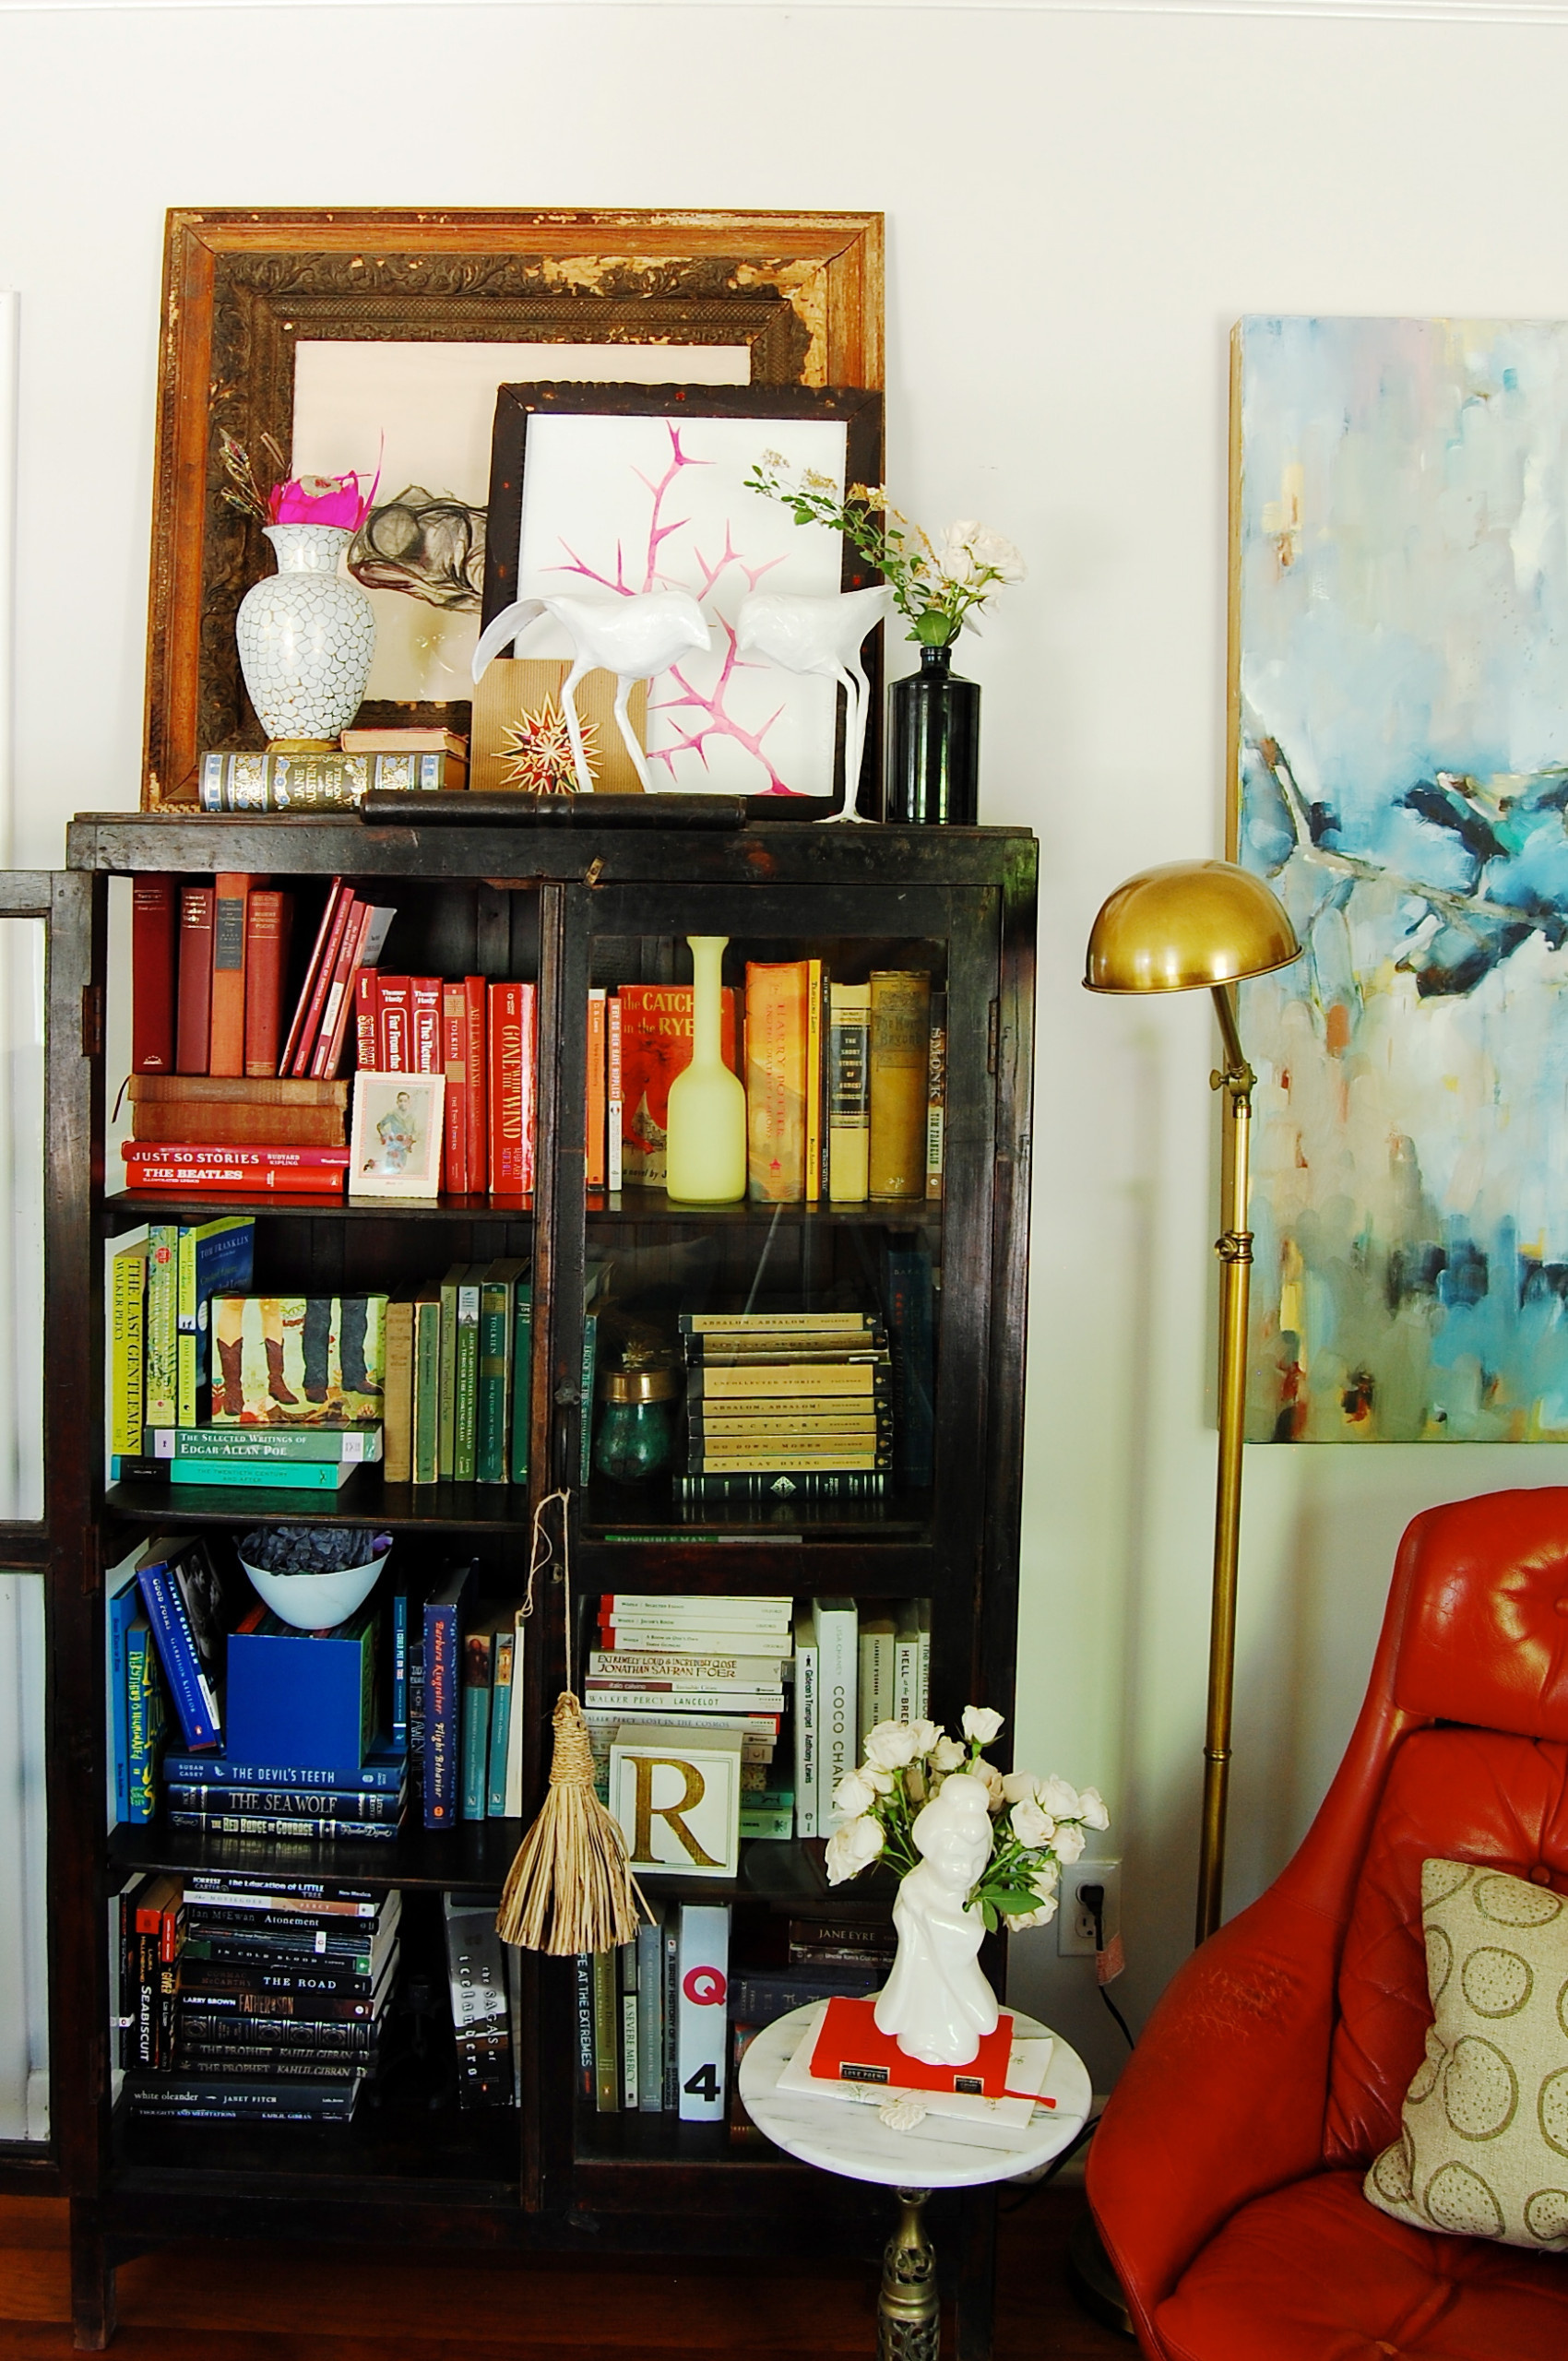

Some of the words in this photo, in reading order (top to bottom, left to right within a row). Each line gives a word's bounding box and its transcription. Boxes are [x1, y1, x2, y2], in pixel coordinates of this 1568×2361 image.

[305, 763, 316, 804] AUSTEN
[624, 993, 641, 1010] the
[388, 1015, 400, 1029] Far
[421, 1018, 433, 1039] The
[624, 1023, 634, 1033] in
[638, 1017, 655, 1034] the
[659, 1017, 694, 1037] RYE
[389, 1031, 401, 1053] From
[776, 1004, 786, 1067] HARRY
[502, 1025, 521, 1070] GONE
[390, 1054, 401, 1069] the
[503, 1096, 521, 1139] WIND
[132, 1153, 170, 1161] JUST
[173, 1153, 193, 1162] SO
[196, 1153, 259, 1164] STORIES
[143, 1168, 174, 1178] THE
[177, 1169, 243, 1180] BEATLES
[214, 1235, 249, 1252] FRANKLIN
[115, 1262, 125, 1309] WALKER
[128, 1262, 140, 1296] THE
[127, 1301, 139, 1342] LAST
[127, 1345, 139, 1449] GENTLEMAN
[180, 1433, 198, 1442] THE
[201, 1433, 246, 1442] SELECTED
[249, 1434, 296, 1443] WRITINGS
[180, 1443, 219, 1454] EDGAR
[221, 1444, 261, 1455] ALLAN
[263, 1446, 288, 1455] POE
[152, 1578, 164, 1602] GOOD
[168, 1581, 183, 1611] JAMES
[179, 1617, 198, 1664] GOLDMAN
[435, 1621, 445, 1661] Barbara
[598, 1655, 641, 1664] EXTREMELY
[643, 1655, 664, 1666] LOUD
[712, 1659, 738, 1668] CLOSE
[599, 1663, 649, 1675] JONATHAN
[651, 1664, 694, 1676] SAFRAN
[696, 1667, 736, 1678] FOER
[901, 1650, 909, 1678] HELL
[432, 1665, 445, 1714] Kingsolver
[804, 1669, 814, 1698] Gideon's
[589, 1695, 629, 1704] WALKER
[673, 1698, 719, 1706] LANCELOT
[833, 1686, 845, 1734] COCO
[804, 1700, 814, 1727] Trumpet
[432, 1722, 445, 1752] Flight
[804, 1734, 814, 1762] Anthony
[232, 1767, 253, 1780] THE
[258, 1768, 296, 1782] DEVIL'S
[302, 1771, 335, 1784] TEETH
[434, 1755, 445, 1797] Behavior
[804, 1763, 814, 1784] Lewis
[229, 1792, 260, 1809] THE
[264, 1794, 292, 1811] SEA
[294, 1796, 338, 1813] WOLF
[621, 1755, 727, 1867] R
[223, 1818, 239, 1832] RED
[240, 1820, 267, 1833] BADGE
[277, 1821, 314, 1836] COURAGE
[244, 1880, 286, 1889] Education
[298, 1883, 325, 1892] LITTLE
[191, 1908, 208, 1917] Ian
[212, 1910, 255, 1921] McEwan
[264, 1915, 320, 1927] Atonement
[300, 1903, 330, 1911] PERCY
[819, 1928, 847, 1940] JANE
[849, 1930, 875, 1940] EYRE
[277, 1955, 317, 1964] BLOOD
[263, 1976, 291, 1987] THE
[298, 1979, 337, 1989] ROAD
[577, 1971, 588, 1985] AT
[682, 1965, 728, 2007] Q
[208, 1998, 236, 2006] BROWN
[239, 1994, 271, 2014] FATHER
[277, 1997, 294, 2015] SON
[578, 1986, 589, 2007] THE
[625, 2001, 635, 2010] A
[139, 1985, 151, 2062] SEABISCUIT
[484, 1990, 499, 2045] SAGAS
[579, 2009, 592, 2067] EXTREMES
[625, 2011, 635, 2047] SEVERE
[669, 2028, 675, 2039] OF
[200, 2045, 222, 2055] THE
[224, 2046, 273, 2057] PROPHET
[279, 2047, 315, 2058] KAHLIL
[316, 2049, 353, 2059] GIBRAN
[197, 2062, 220, 2071] THE
[222, 2063, 270, 2073] PROPHET
[277, 2065, 313, 2074] KAHLIL
[314, 2066, 350, 2076] GIBRAN
[625, 2048, 635, 2083] MERCY
[863, 2071, 886, 2080] POEMS
[683, 2063, 721, 2103] 4
[134, 2090, 159, 2100] white
[161, 2091, 198, 2102] oleander
[222, 2095, 248, 2104] JANET
